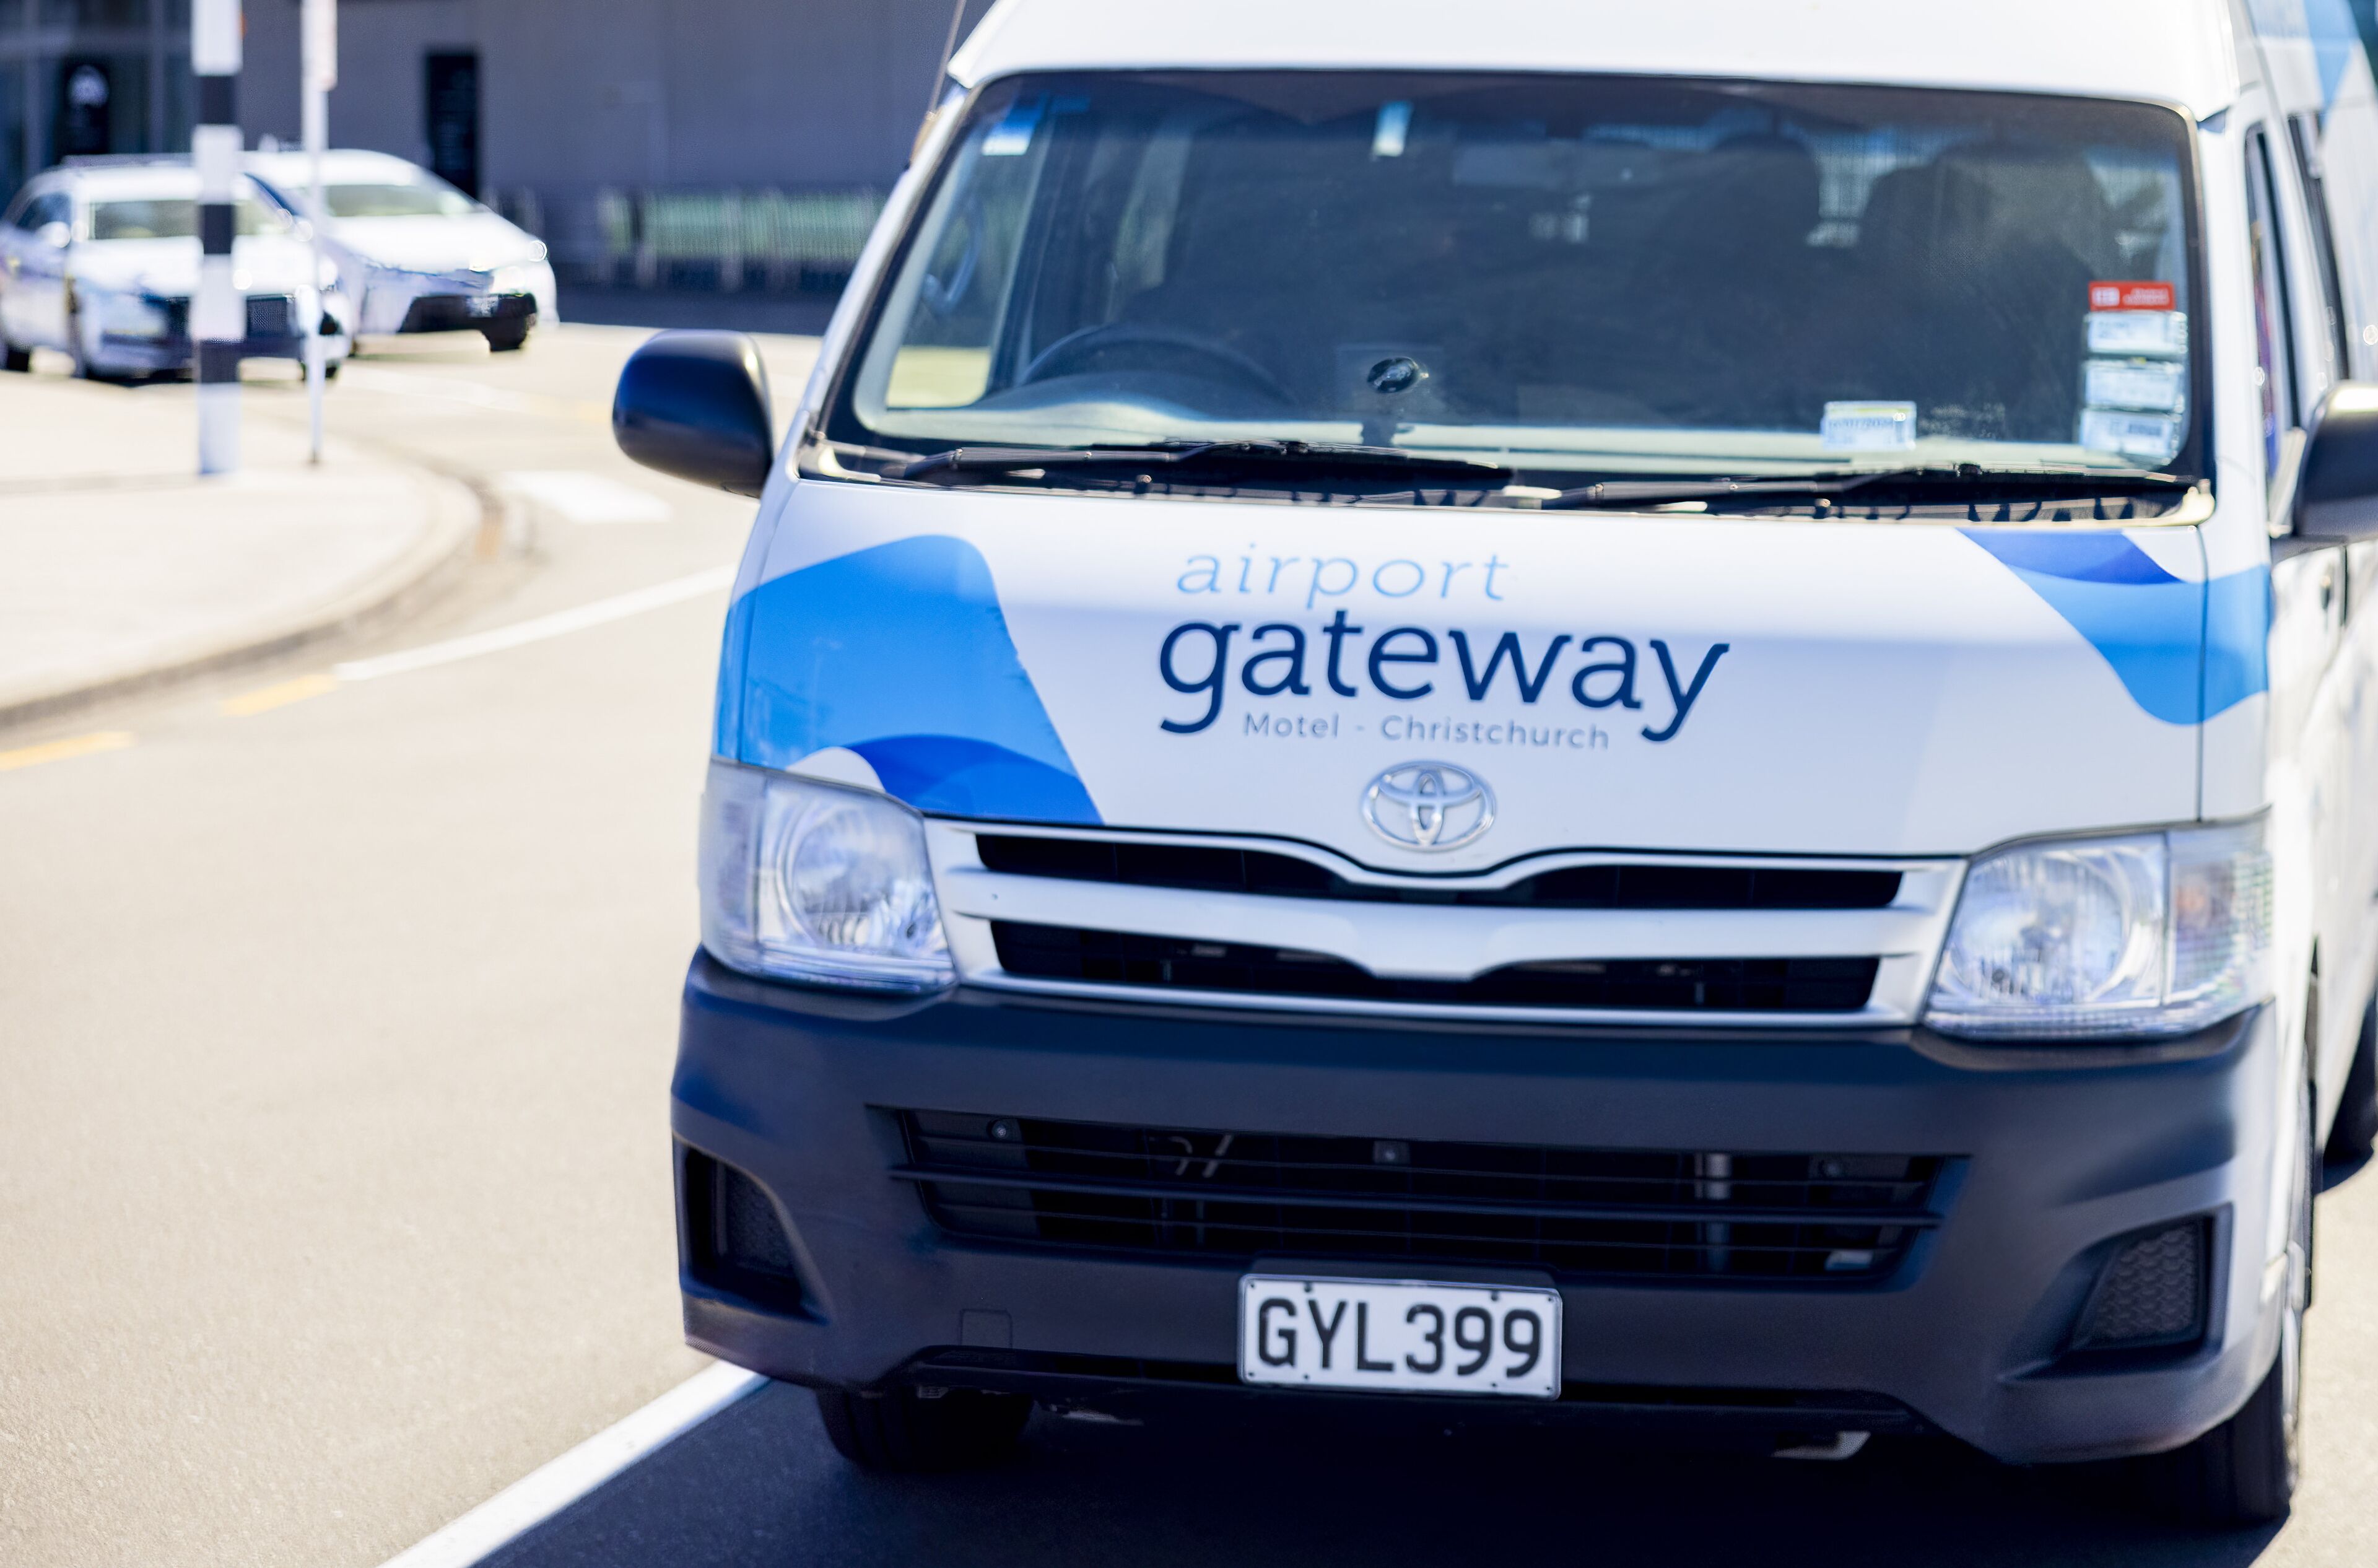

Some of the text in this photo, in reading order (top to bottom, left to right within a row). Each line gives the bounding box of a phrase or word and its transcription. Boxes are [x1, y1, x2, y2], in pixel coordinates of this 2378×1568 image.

[1176, 543, 1509, 609] airport
[1160, 611, 1730, 742] gateway
[1243, 712, 1339, 738] Motel
[1380, 715, 1609, 749] Christchurch
[1258, 1297, 1542, 1379] GYL399
